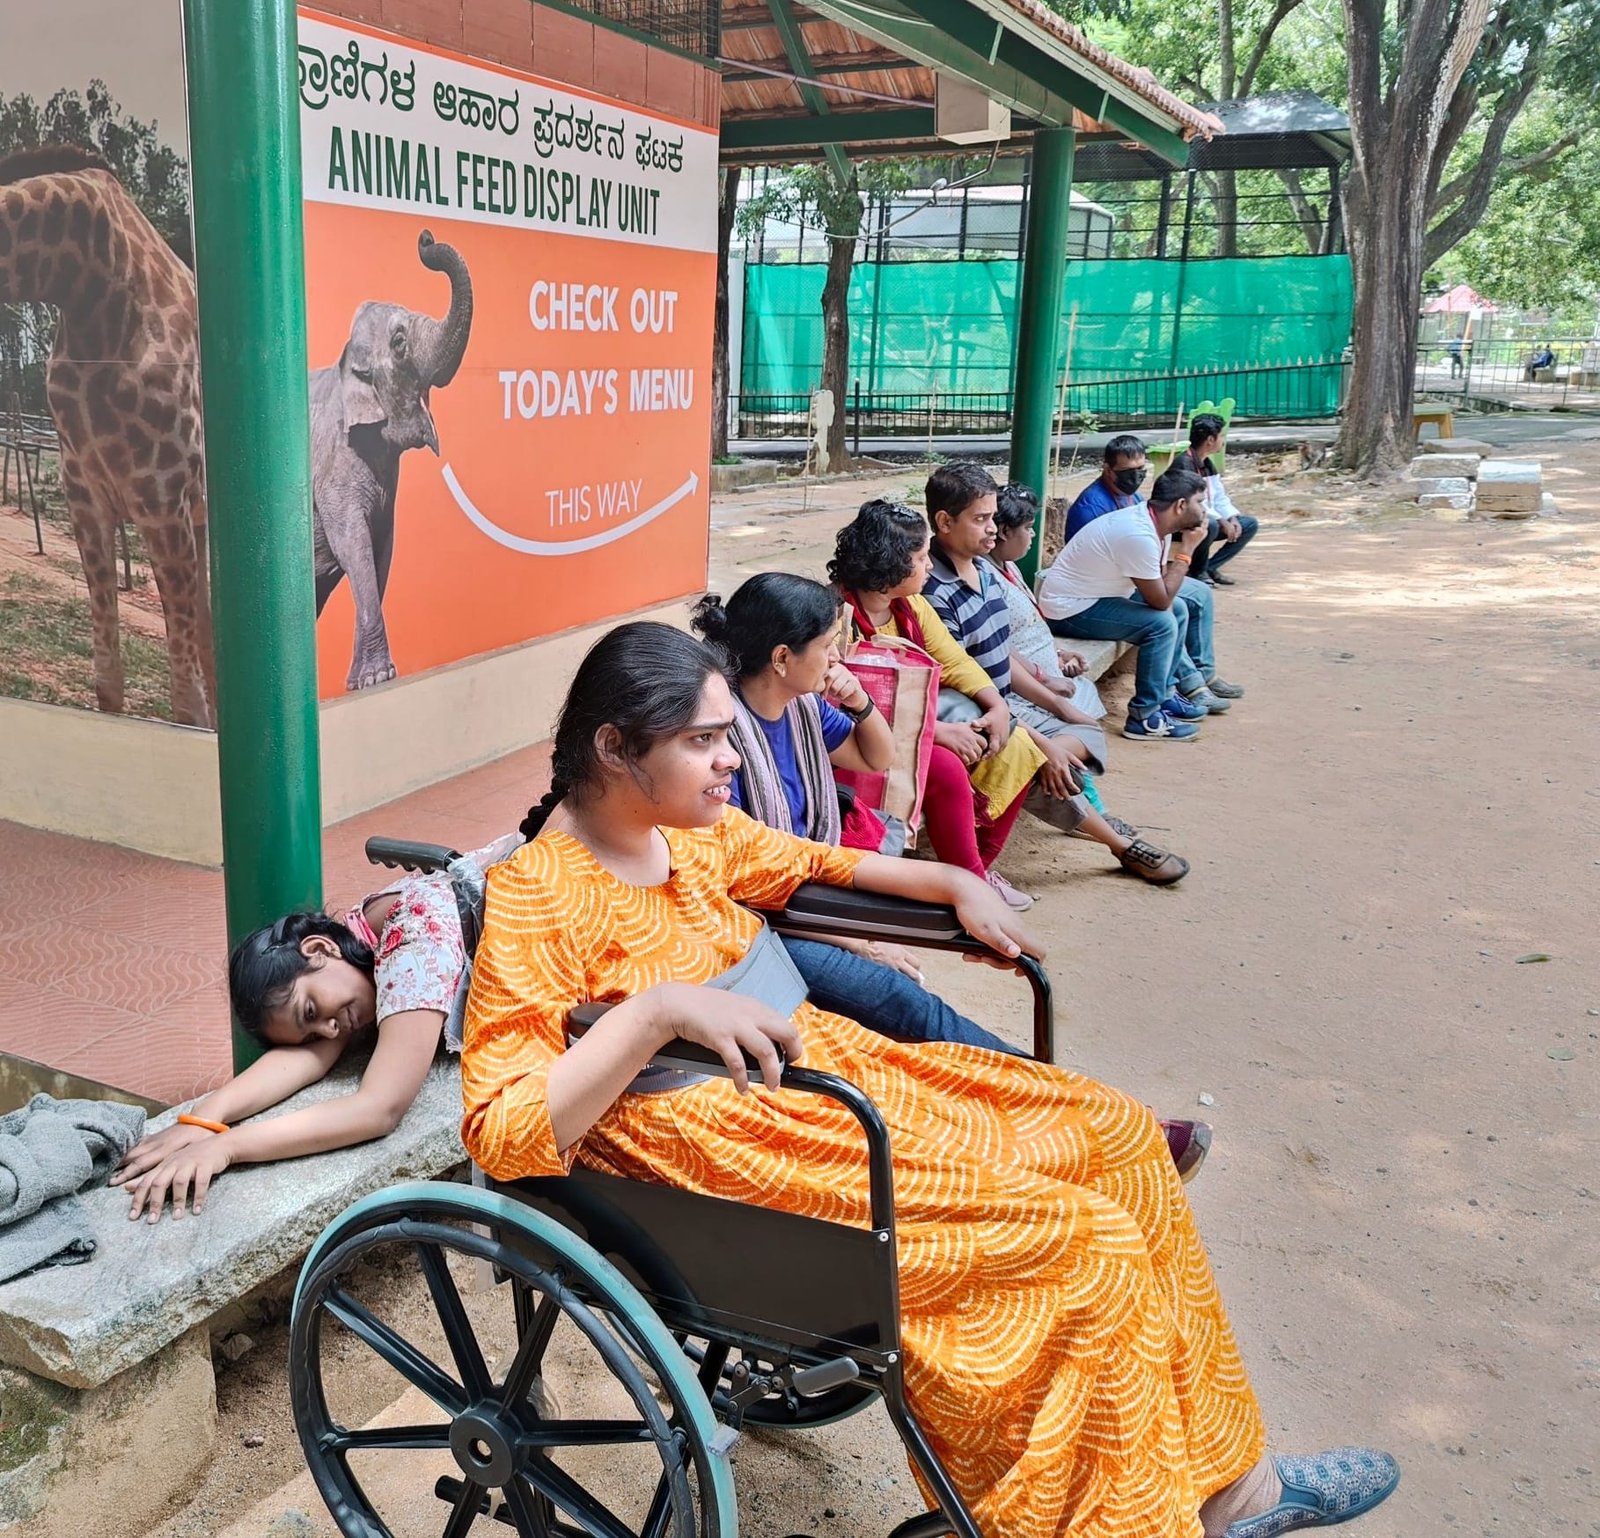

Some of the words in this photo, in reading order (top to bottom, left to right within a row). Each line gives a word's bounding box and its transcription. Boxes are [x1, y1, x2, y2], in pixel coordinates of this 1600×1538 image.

[433, 81, 519, 136] ಆಹಾರ
[533, 98, 625, 160] ಪ್ರದರ್ಶನ
[635, 126, 684, 173] ಘಟಕ
[328, 126, 449, 206] ANIMAL
[457, 152, 516, 216] FEED
[523, 164, 612, 228] DISPLAY
[618, 182, 660, 236] UNIT
[529, 280, 619, 332] CHECK
[630, 288, 678, 334] OUT
[498, 368, 619, 419] TODAY'S
[629, 369, 694, 412] MENU
[545, 485, 591, 527] THIS
[597, 478, 642, 518] WAY
